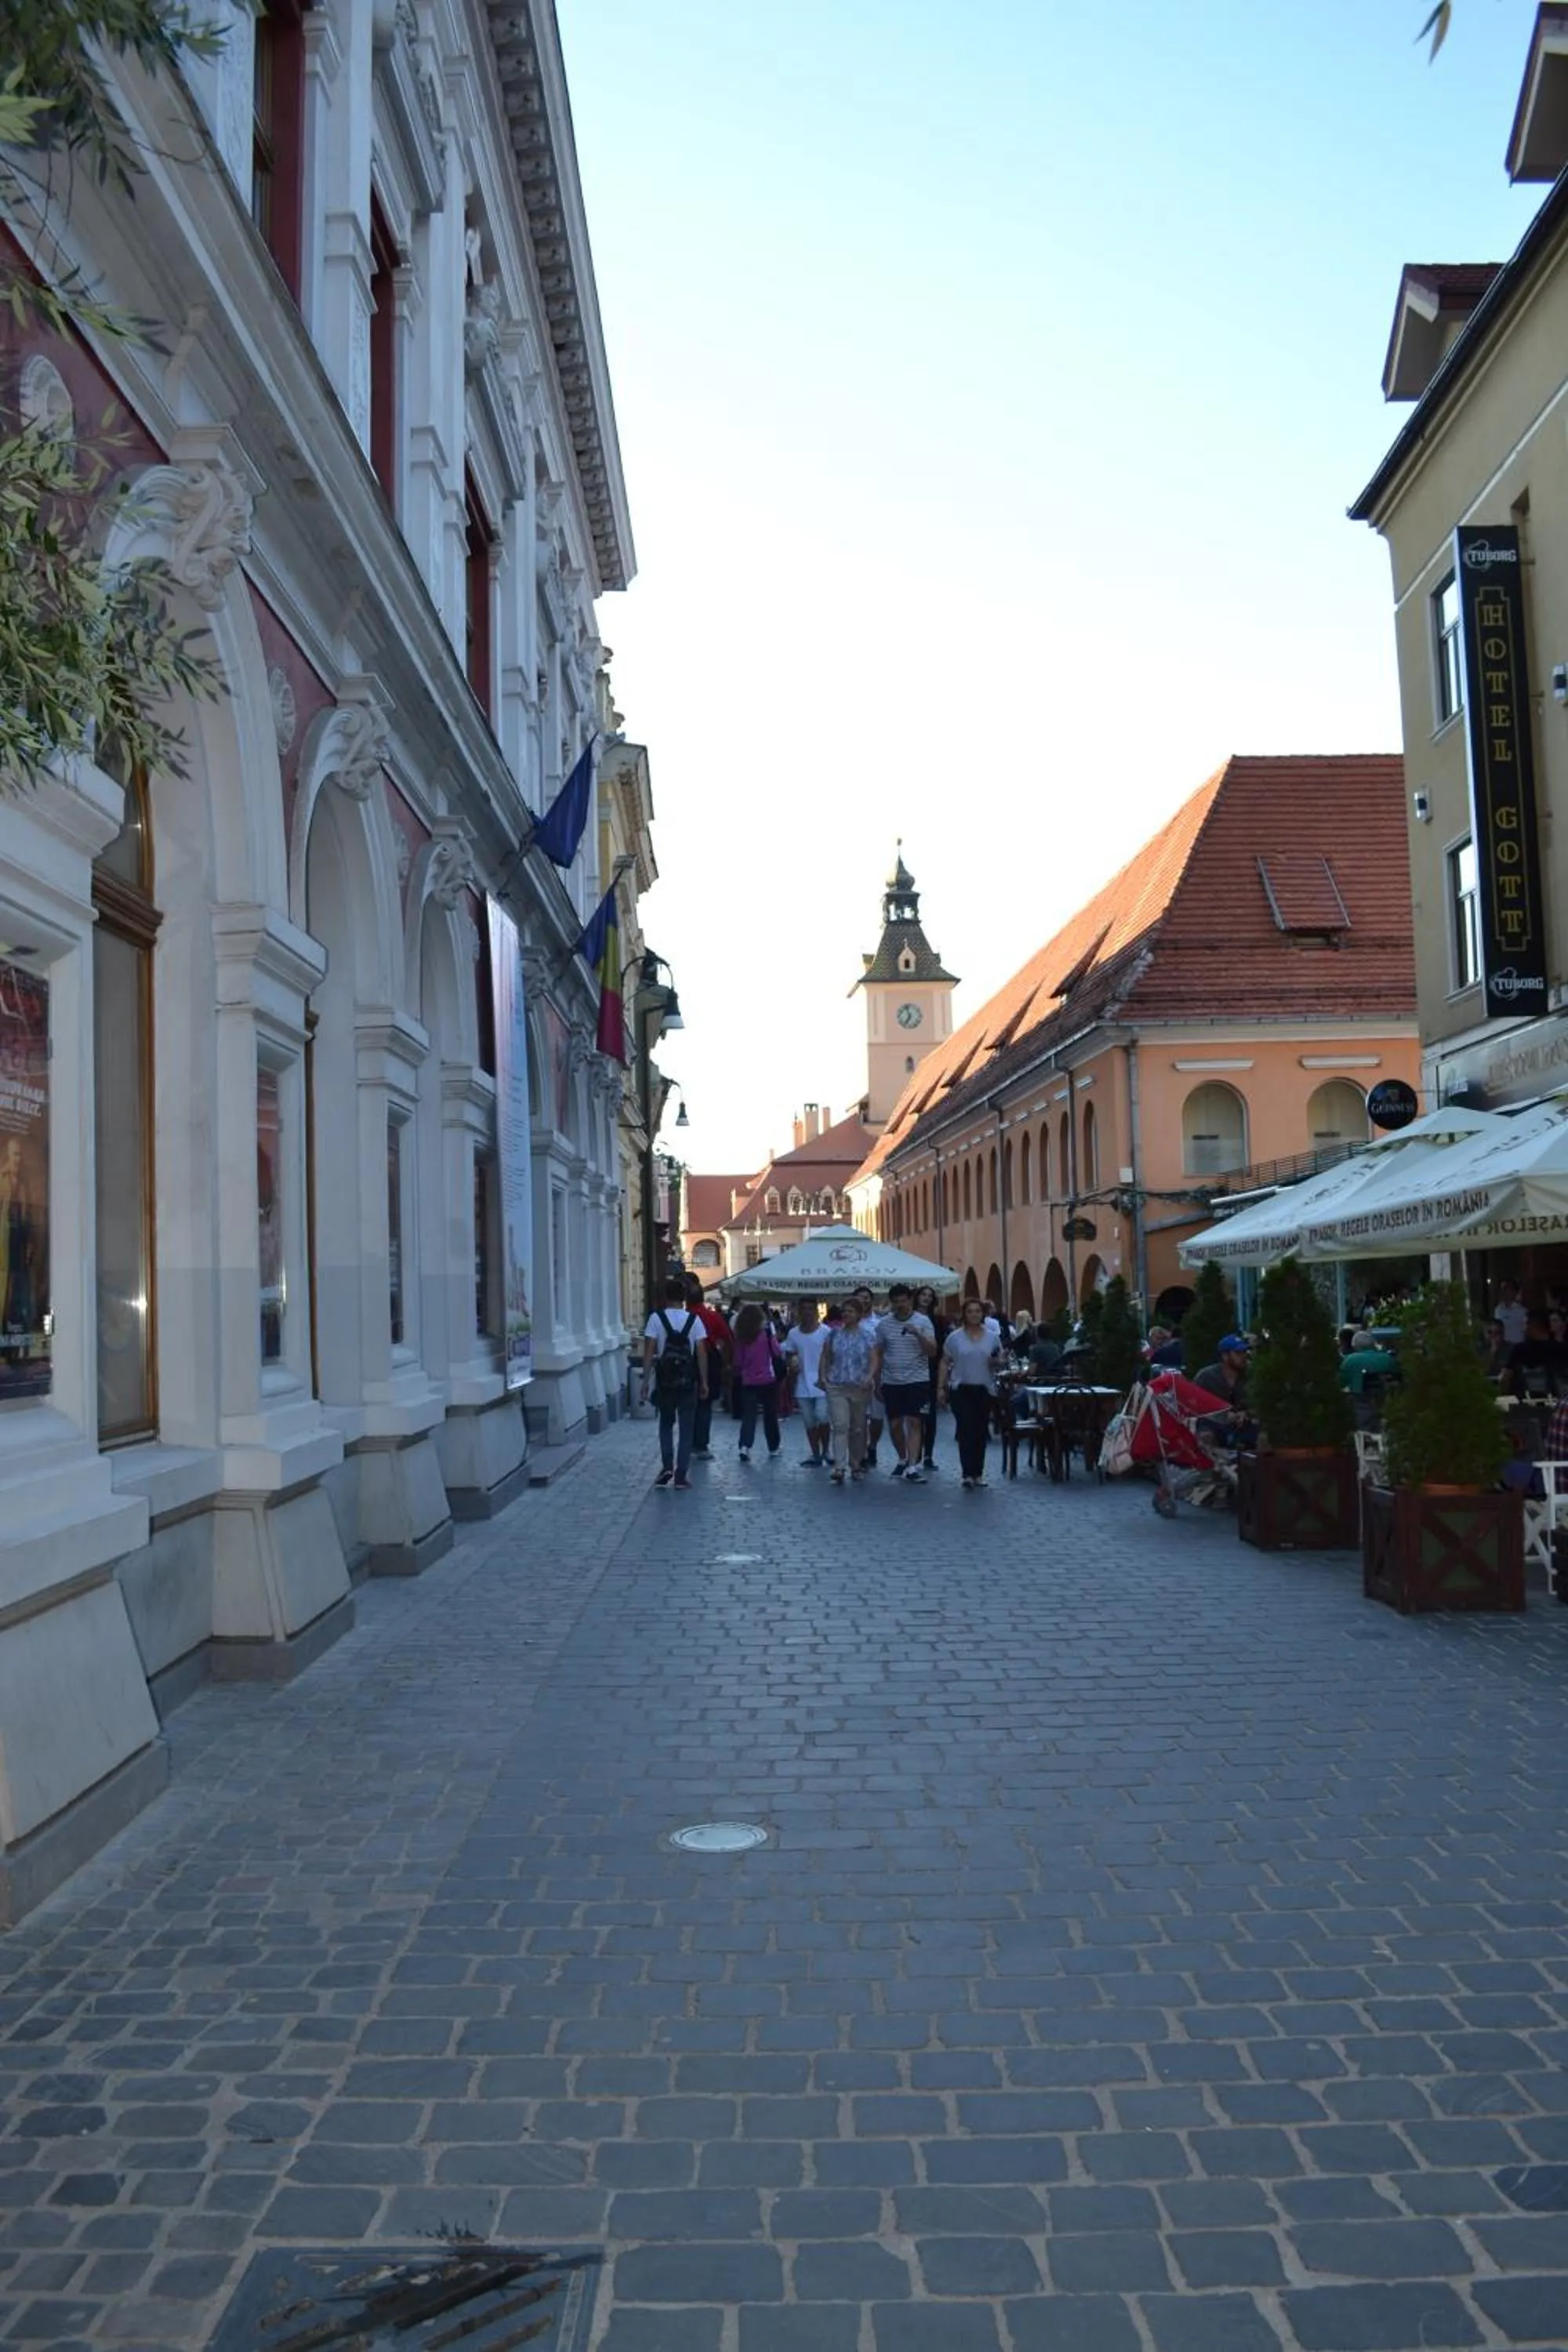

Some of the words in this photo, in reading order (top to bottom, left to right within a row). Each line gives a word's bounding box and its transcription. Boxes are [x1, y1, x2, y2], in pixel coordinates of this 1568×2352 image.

[1468, 550, 1517, 562] TUBORG
[1482, 604, 1512, 761] HOTEL
[1495, 806, 1523, 933] GOTT
[1494, 977, 1544, 989] TUBORG
